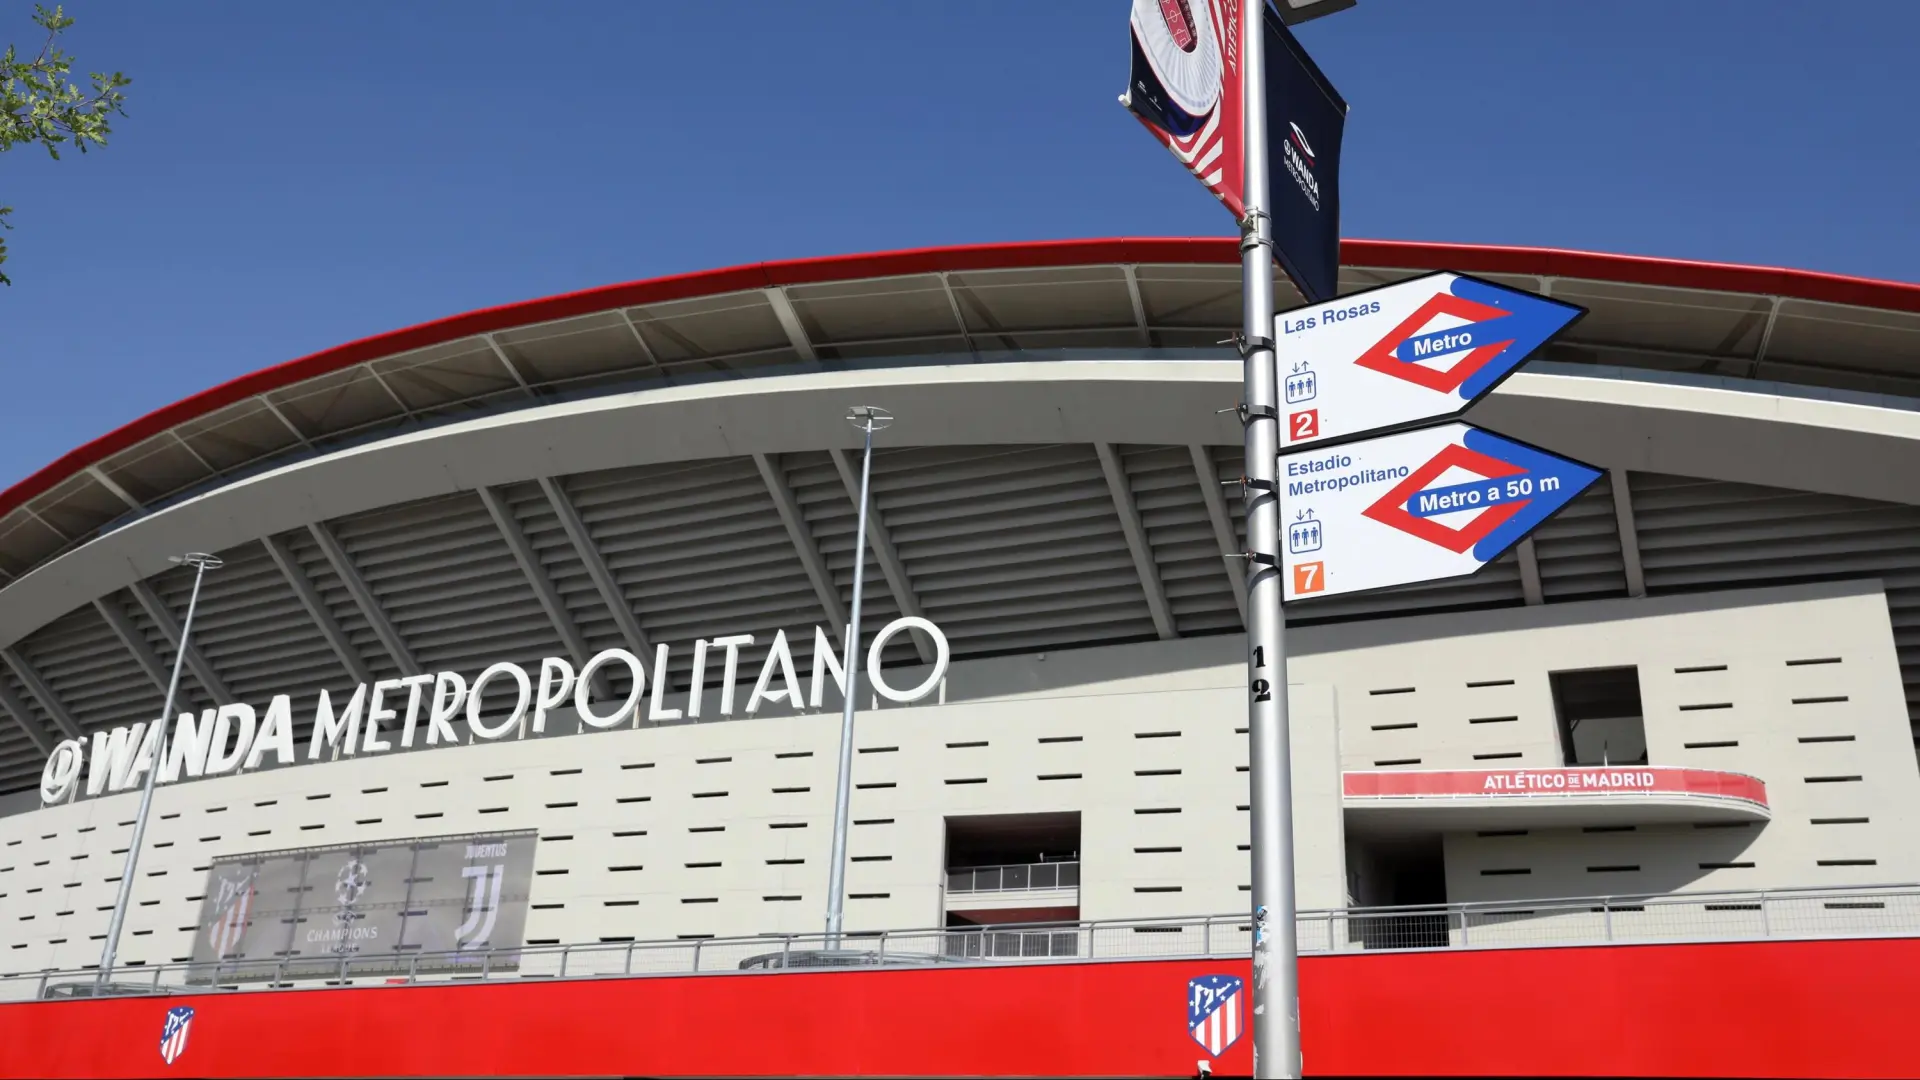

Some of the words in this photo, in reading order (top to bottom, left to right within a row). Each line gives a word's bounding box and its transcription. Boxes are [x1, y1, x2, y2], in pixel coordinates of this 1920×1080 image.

[1283, 155, 1320, 211] METROPOLITANO
[1291, 147, 1319, 199] WANDA
[1284, 317, 1316, 334] Las
[1323, 301, 1381, 325] Rosas
[1414, 330, 1472, 356] Metro
[1295, 414, 1314, 437] 2
[1287, 455, 1352, 477] Estadio
[1288, 465, 1410, 497] Metropolitano
[1419, 489, 1481, 513] Metro
[1487, 488, 1500, 501] a
[1507, 478, 1533, 498] 50
[1540, 475, 1560, 492] m
[1300, 565, 1319, 590] 7
[87, 694, 295, 796] WANDA
[307, 616, 950, 761] METROPOLITANO
[1484, 772, 1565, 789] ATLÉTICO
[1568, 776, 1580, 785] DE
[1583, 772, 1654, 787] MADRID
[464, 842, 508, 859] JUVENTUS
[307, 926, 378, 942] CHAMPIONS
